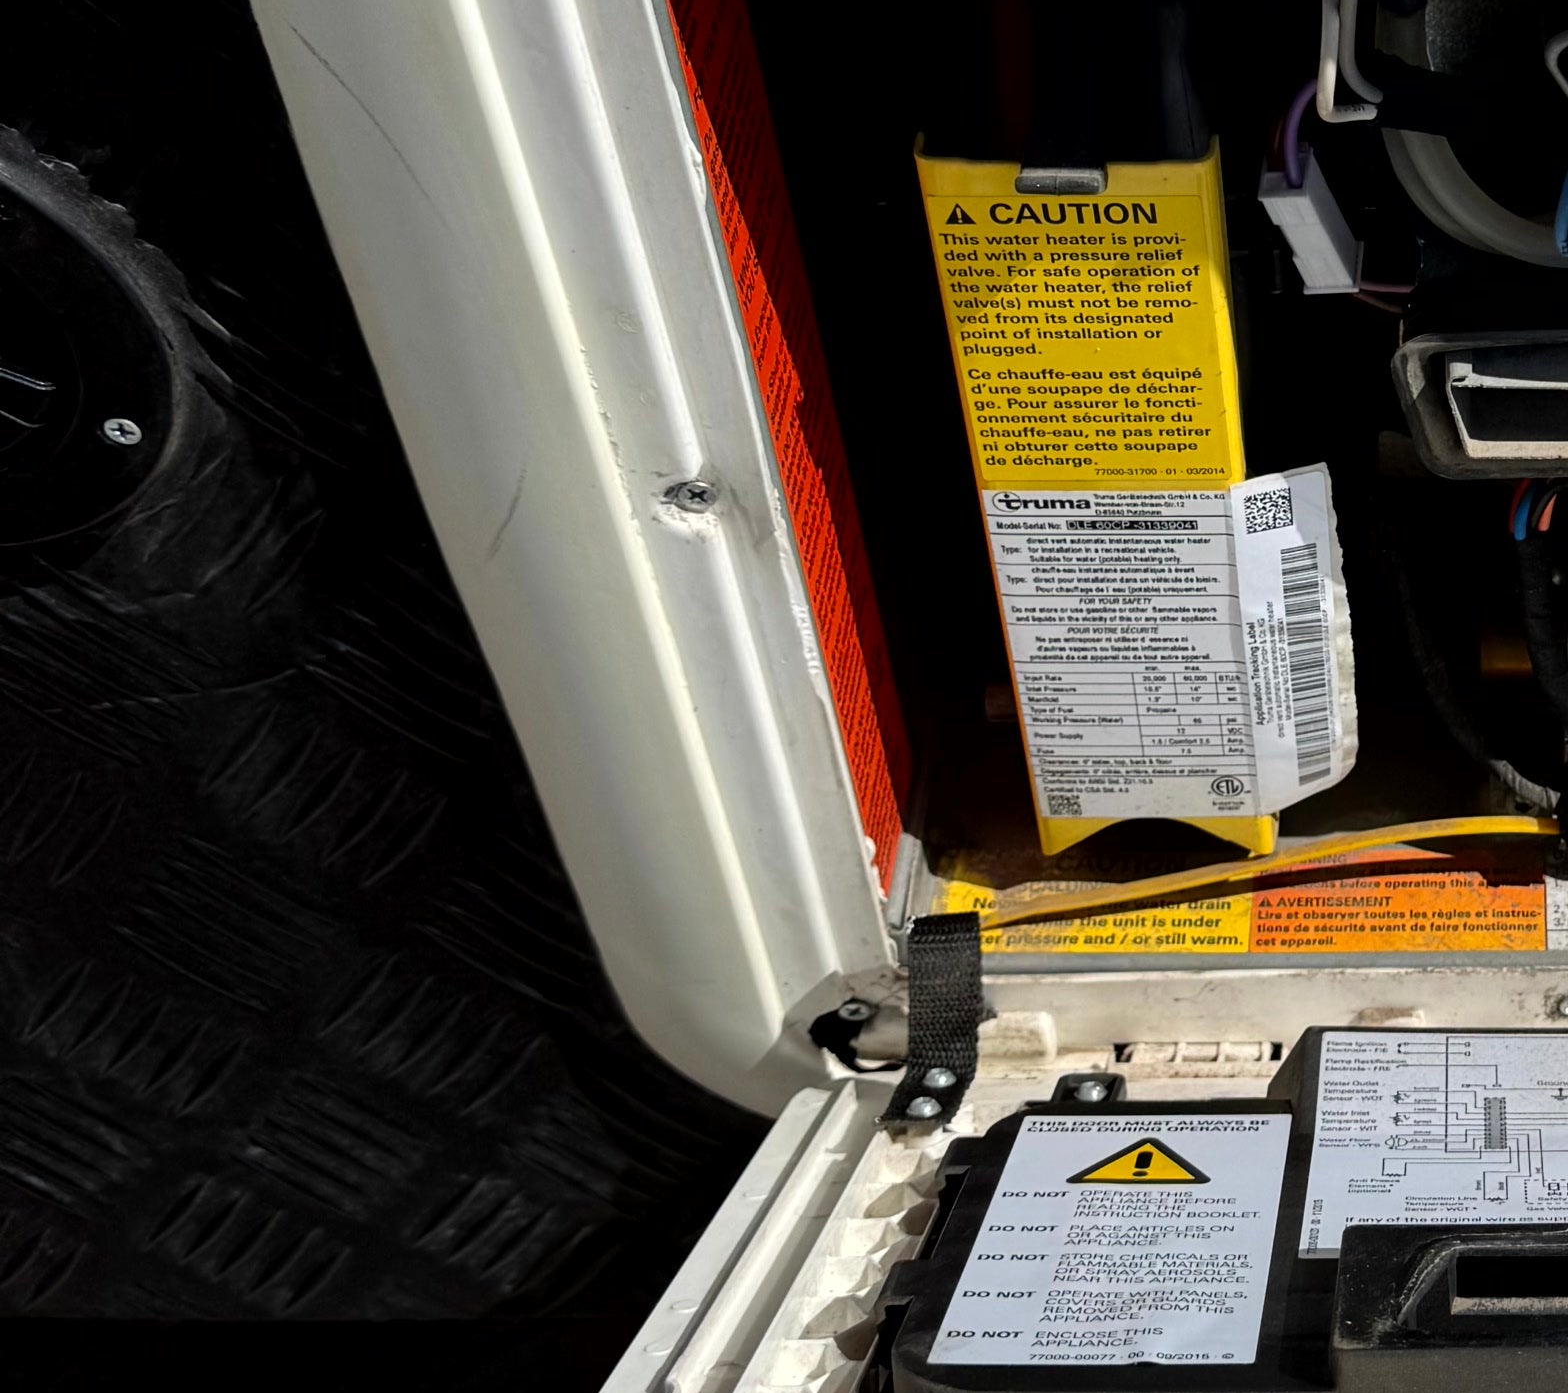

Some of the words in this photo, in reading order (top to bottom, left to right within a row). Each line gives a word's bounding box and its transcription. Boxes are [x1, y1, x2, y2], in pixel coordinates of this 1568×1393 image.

[990, 203, 1157, 224] CAUTION
[939, 234, 979, 245] This
[985, 235, 1040, 245] water
[1046, 234, 1105, 245] heater
[1112, 233, 1127, 245] is
[1133, 233, 1186, 246] provi-
[944, 250, 978, 261] ded
[984, 250, 1026, 261] with
[1033, 252, 1043, 261] a
[1050, 252, 1130, 263] pressure
[1136, 249, 1182, 260] relief
[947, 266, 1000, 277] valve.
[1007, 266, 1036, 277] For
[1043, 266, 1081, 277] safe
[1088, 265, 1175, 278] operation
[1182, 265, 1200, 276] of
[950, 282, 979, 292] the
[986, 283, 1038, 292] water
[1044, 282, 1106, 294] heater,
[1112, 281, 1141, 292] the
[1148, 280, 1192, 292] relief
[954, 297, 1020, 310] valve(s)
[1028, 298, 1074, 308] must
[1080, 298, 1111, 308] not
[1116, 297, 1138, 308] be
[1145, 299, 1198, 308] remo-
[957, 313, 989, 324] ved
[995, 313, 1038, 324] from
[1044, 313, 1067, 324] its
[1073, 312, 1173, 326] designated
[961, 328, 1007, 341] point
[1013, 328, 1030, 339] of
[1037, 328, 1137, 339] installation
[1144, 330, 1162, 338] or
[964, 344, 1042, 356] plugged.
[968, 369, 991, 380] Ce
[997, 369, 1103, 380] chauffe-eau
[1109, 370, 1136, 379] est
[1142, 368, 1202, 381] équipé
[971, 384, 1021, 394] d'une
[1027, 386, 1102, 396] soupape
[1109, 383, 1130, 394] de
[1136, 383, 1202, 394] déchar-
[974, 401, 1000, 410] ge.
[1007, 398, 1047, 409] Pour
[1054, 400, 1118, 408] assurer
[1124, 398, 1139, 408] le
[1145, 397, 1202, 408] foncti-
[977, 414, 1067, 423] onnement
[1073, 412, 1164, 423] sécuritaire
[1171, 412, 1192, 422] du
[980, 427, 1088, 438] chauffe-eau,
[1122, 429, 1152, 439] pas
[1159, 426, 1211, 436] retirer
[983, 442, 998, 451] ni
[1004, 442, 1068, 451] obturer
[1074, 442, 1118, 451] cette
[1124, 443, 1197, 452] soupape
[986, 455, 1006, 465] de
[1012, 455, 1098, 467] décharge.
[994, 492, 1091, 512] truma
[1246, 622, 1256, 645] Label
[1251, 646, 1260, 681] Tracking
[1253, 682, 1266, 725] Application
[1276, 896, 1392, 907] AVERTISSEMENT
[1258, 910, 1282, 920] Lire
[1286, 911, 1298, 919] et
[1303, 910, 1360, 920] observer
[1364, 910, 1405, 919] toutes
[1410, 910, 1429, 920] les
[1432, 910, 1471, 920] règles
[1475, 910, 1488, 918] et
[1492, 910, 1541, 918] instruc-
[1113, 916, 1146, 927] unit
[1152, 916, 1166, 927] is
[1172, 916, 1222, 928] under
[1257, 923, 1290, 932] tions
[1294, 924, 1310, 932] de
[1314, 923, 1366, 932] sécurité
[1370, 924, 1406, 932] avant
[1410, 922, 1426, 932] de
[1430, 922, 1459, 932] faire
[1463, 922, 1538, 932] fonctionner
[1084, 933, 1116, 944] and
[1120, 933, 1128, 944] /
[1132, 936, 1151, 945] or
[1156, 933, 1186, 946] still
[1191, 936, 1242, 945] warm.
[1256, 938, 1276, 946] cet
[1280, 936, 1336, 947] appareil.
